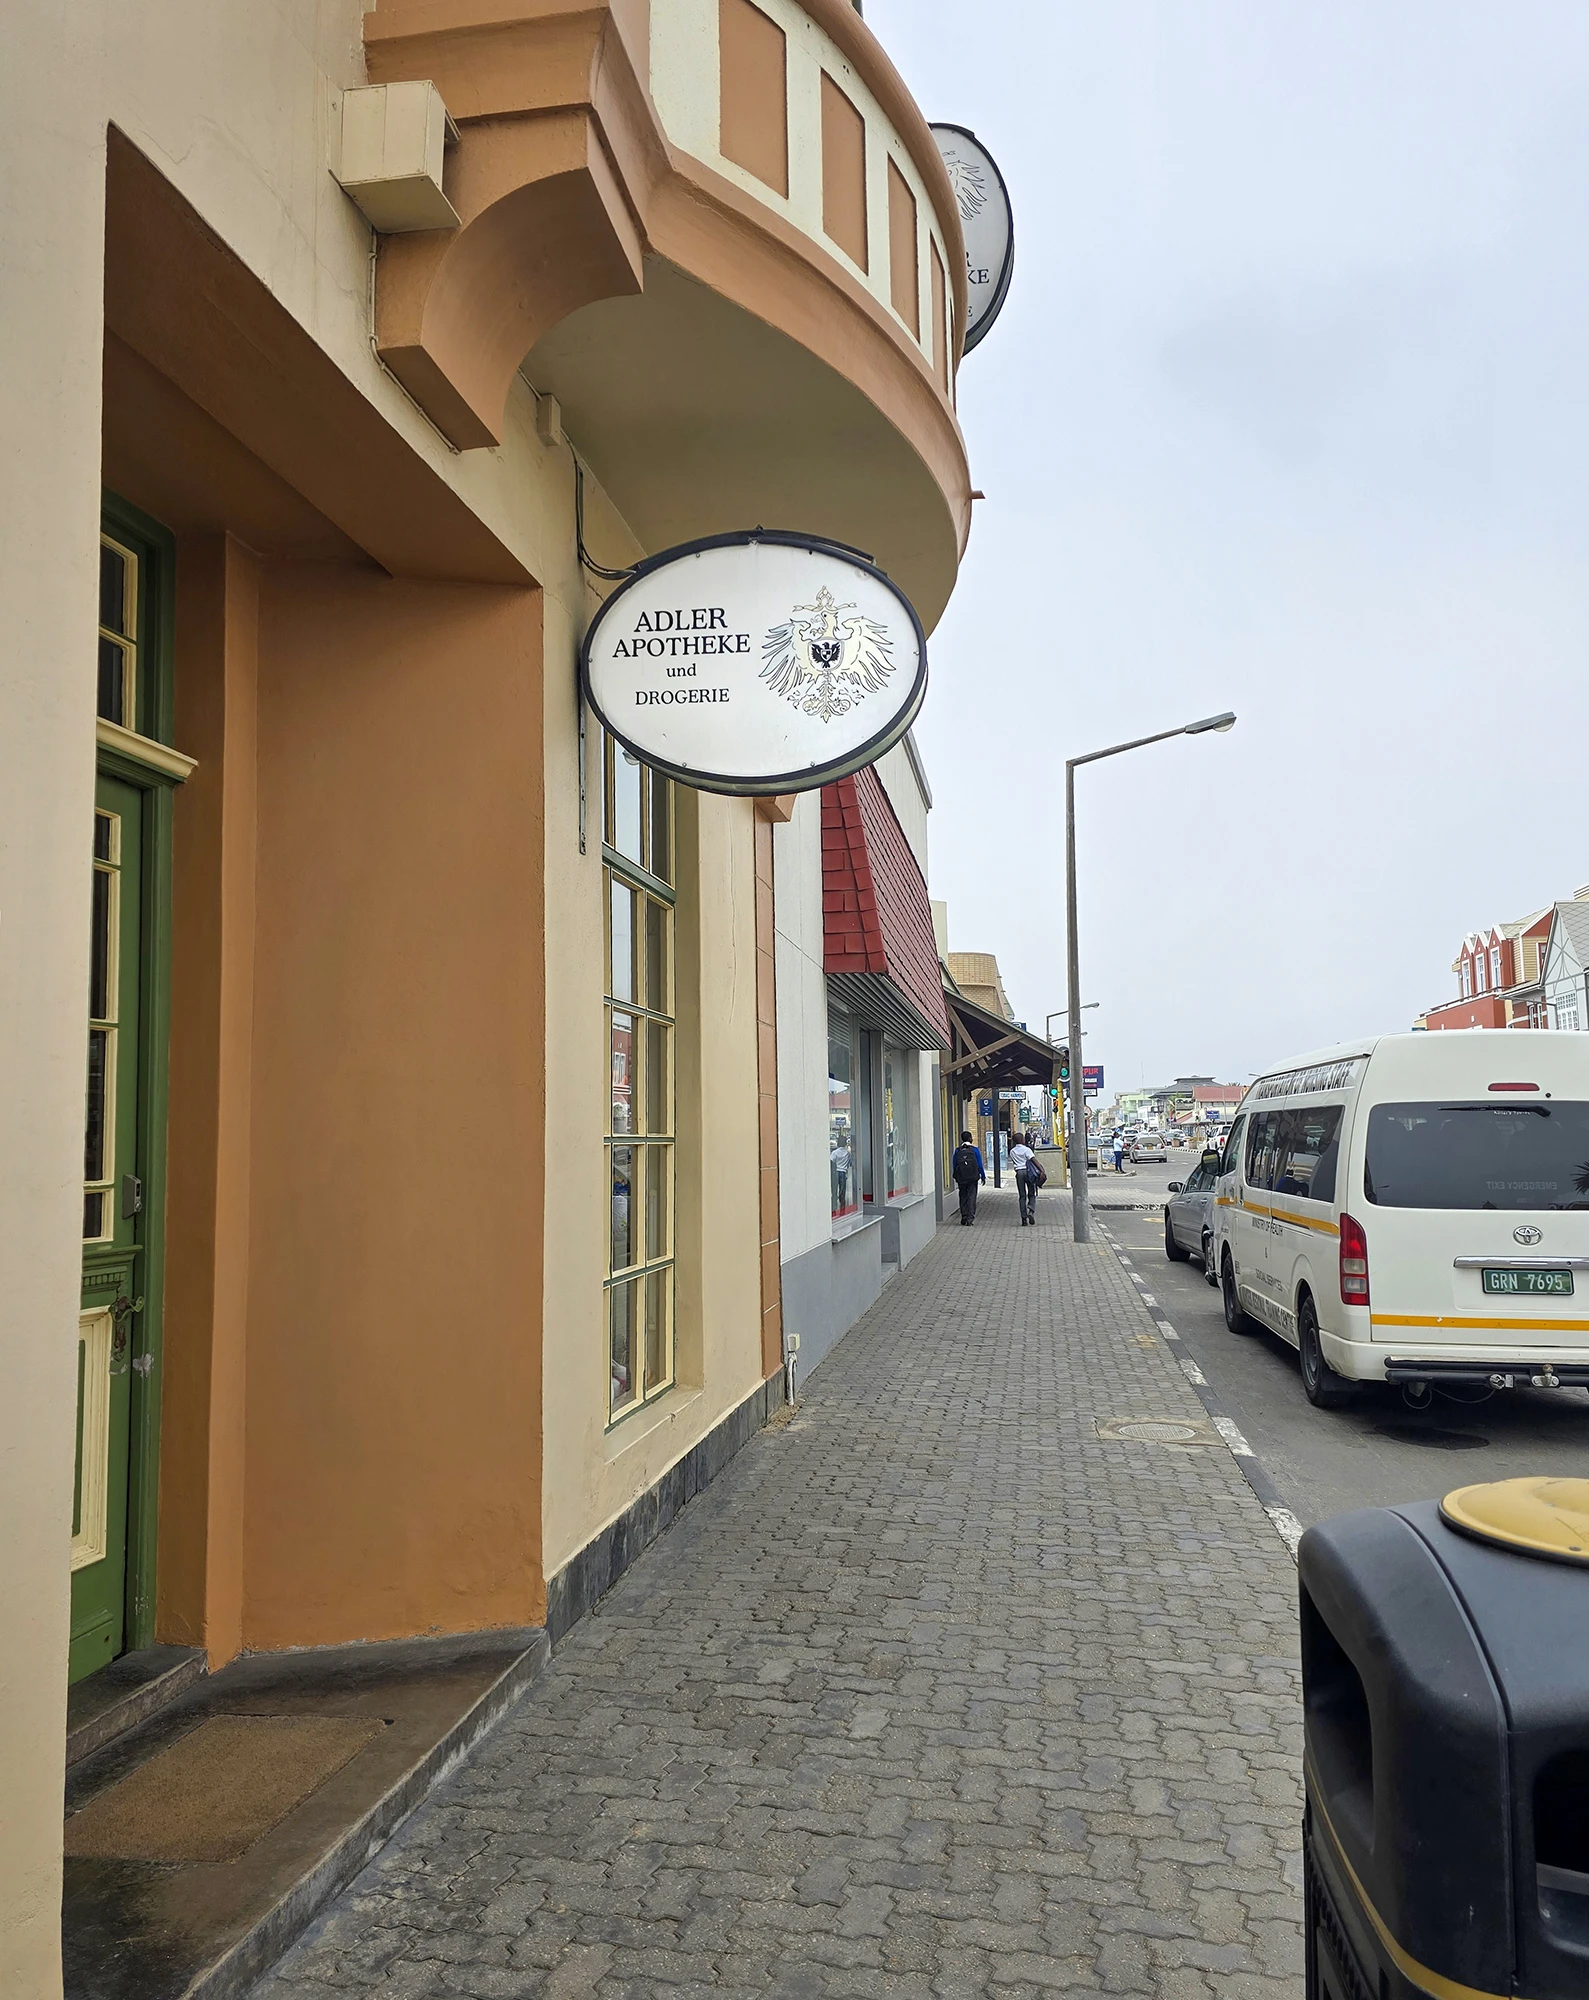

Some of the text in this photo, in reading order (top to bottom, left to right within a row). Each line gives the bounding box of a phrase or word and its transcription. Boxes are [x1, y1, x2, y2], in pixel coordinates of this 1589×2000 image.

[633, 607, 729, 633] ADLER
[612, 634, 751, 658] APOTHEKE
[666, 663, 697, 678] und
[635, 688, 730, 706] DROGERIE
[1082, 1067, 1099, 1077] PUR
[1491, 1273, 1563, 1291] GRN 7695
